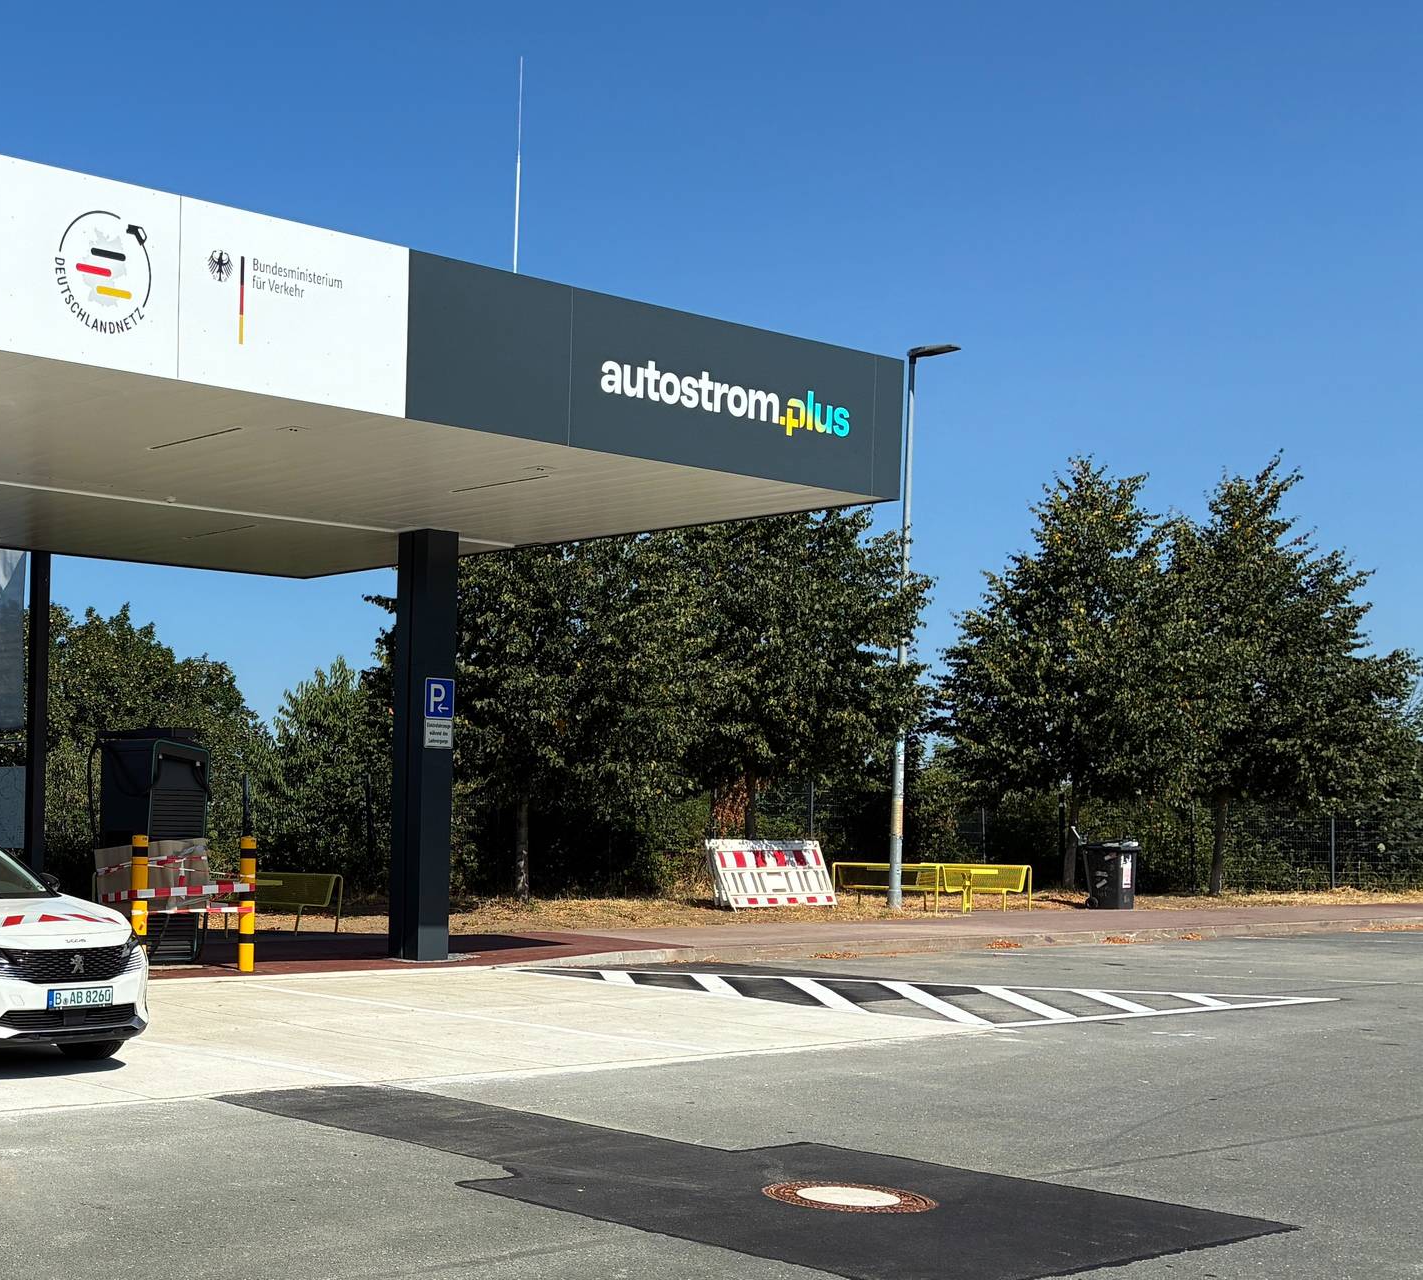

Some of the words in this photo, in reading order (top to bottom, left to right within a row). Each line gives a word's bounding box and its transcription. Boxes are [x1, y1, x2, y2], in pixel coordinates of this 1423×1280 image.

[252, 258, 343, 289] Bundesministerium
[252, 275, 266, 291] für
[268, 278, 305, 299] Verkehr
[54, 257, 145, 334] DEUTSCHLANDNETZ
[600, 360, 850, 437] autostrom.plus
[430, 683, 446, 713] P
[55, 992, 62, 1005] B
[69, 991, 83, 1005] AB
[85, 989, 111, 1003] 8260
